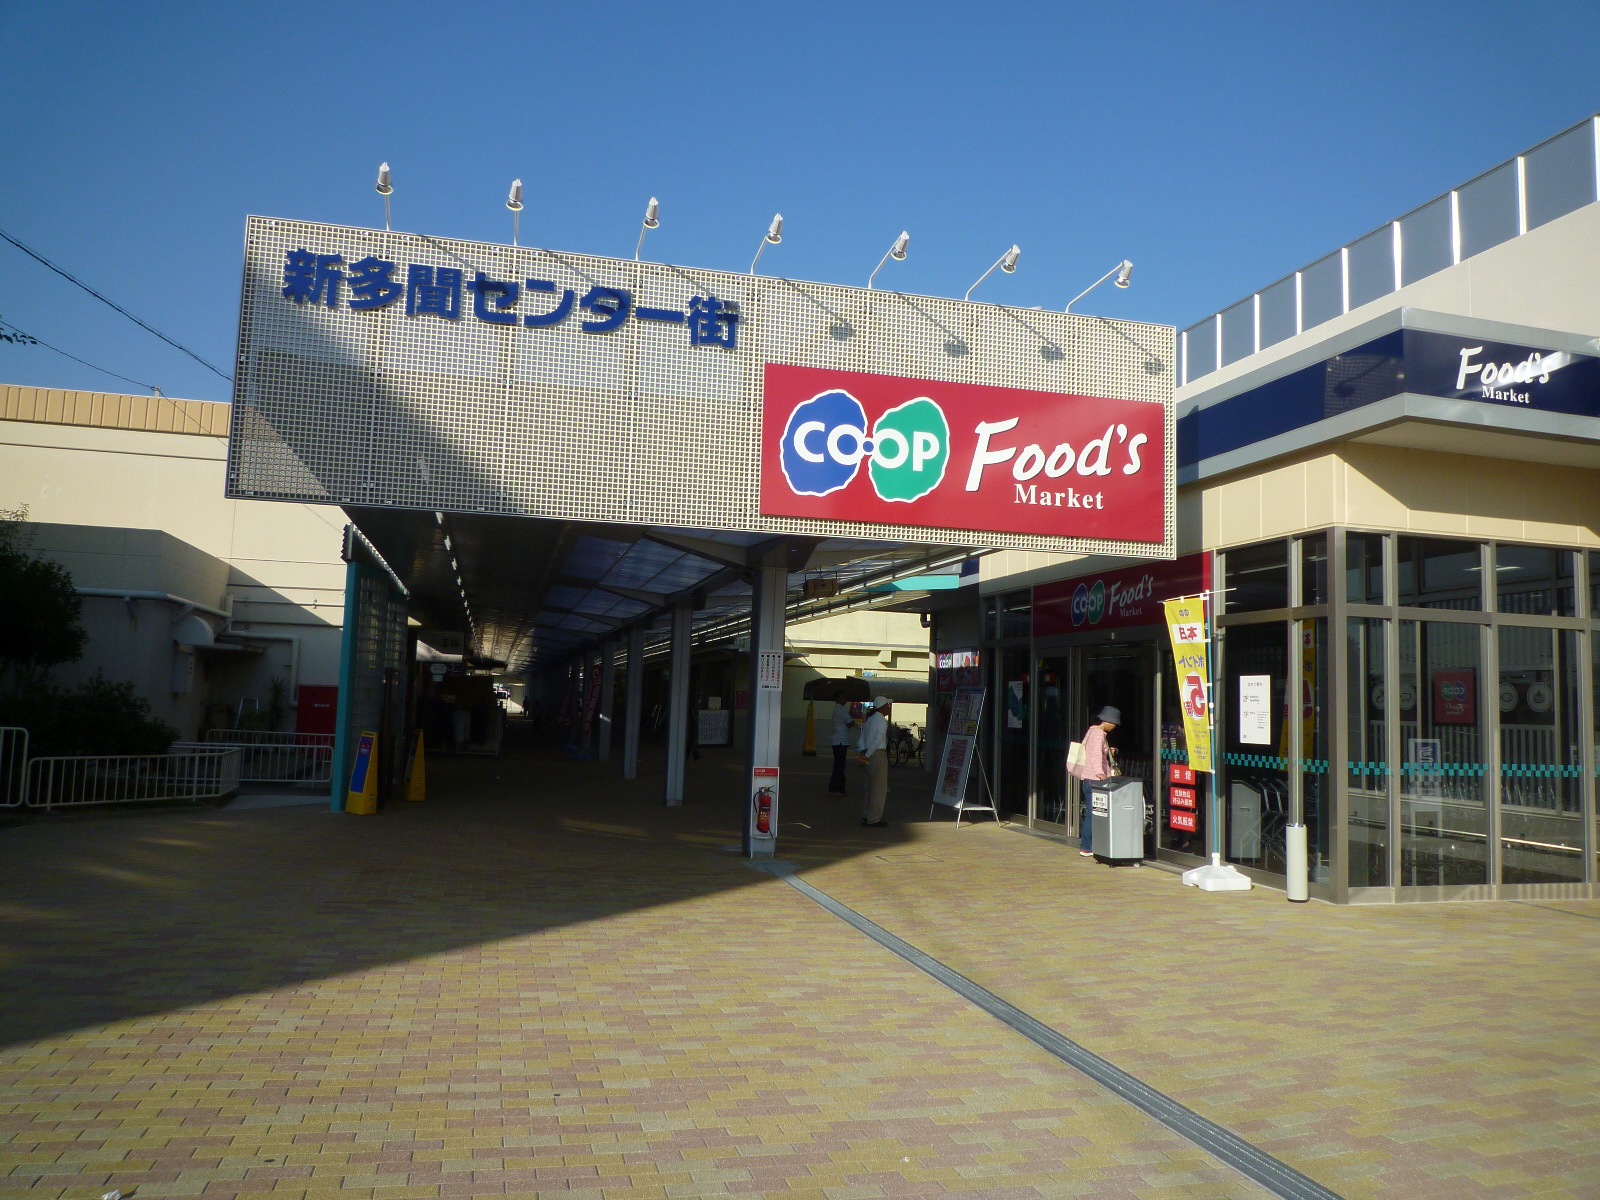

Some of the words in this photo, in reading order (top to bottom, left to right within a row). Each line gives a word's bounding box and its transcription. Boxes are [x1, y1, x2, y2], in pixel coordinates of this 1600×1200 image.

[282, 247, 739, 350] 新多聞センター街
[1456, 346, 1550, 390] Food's
[1482, 385, 1530, 404] Market
[965, 416, 1148, 492] Food's
[1014, 483, 1105, 511] Market
[1109, 574, 1154, 615] Food's
[1119, 607, 1142, 618] Market
[1172, 814, 1194, 827] 火気厳禁
